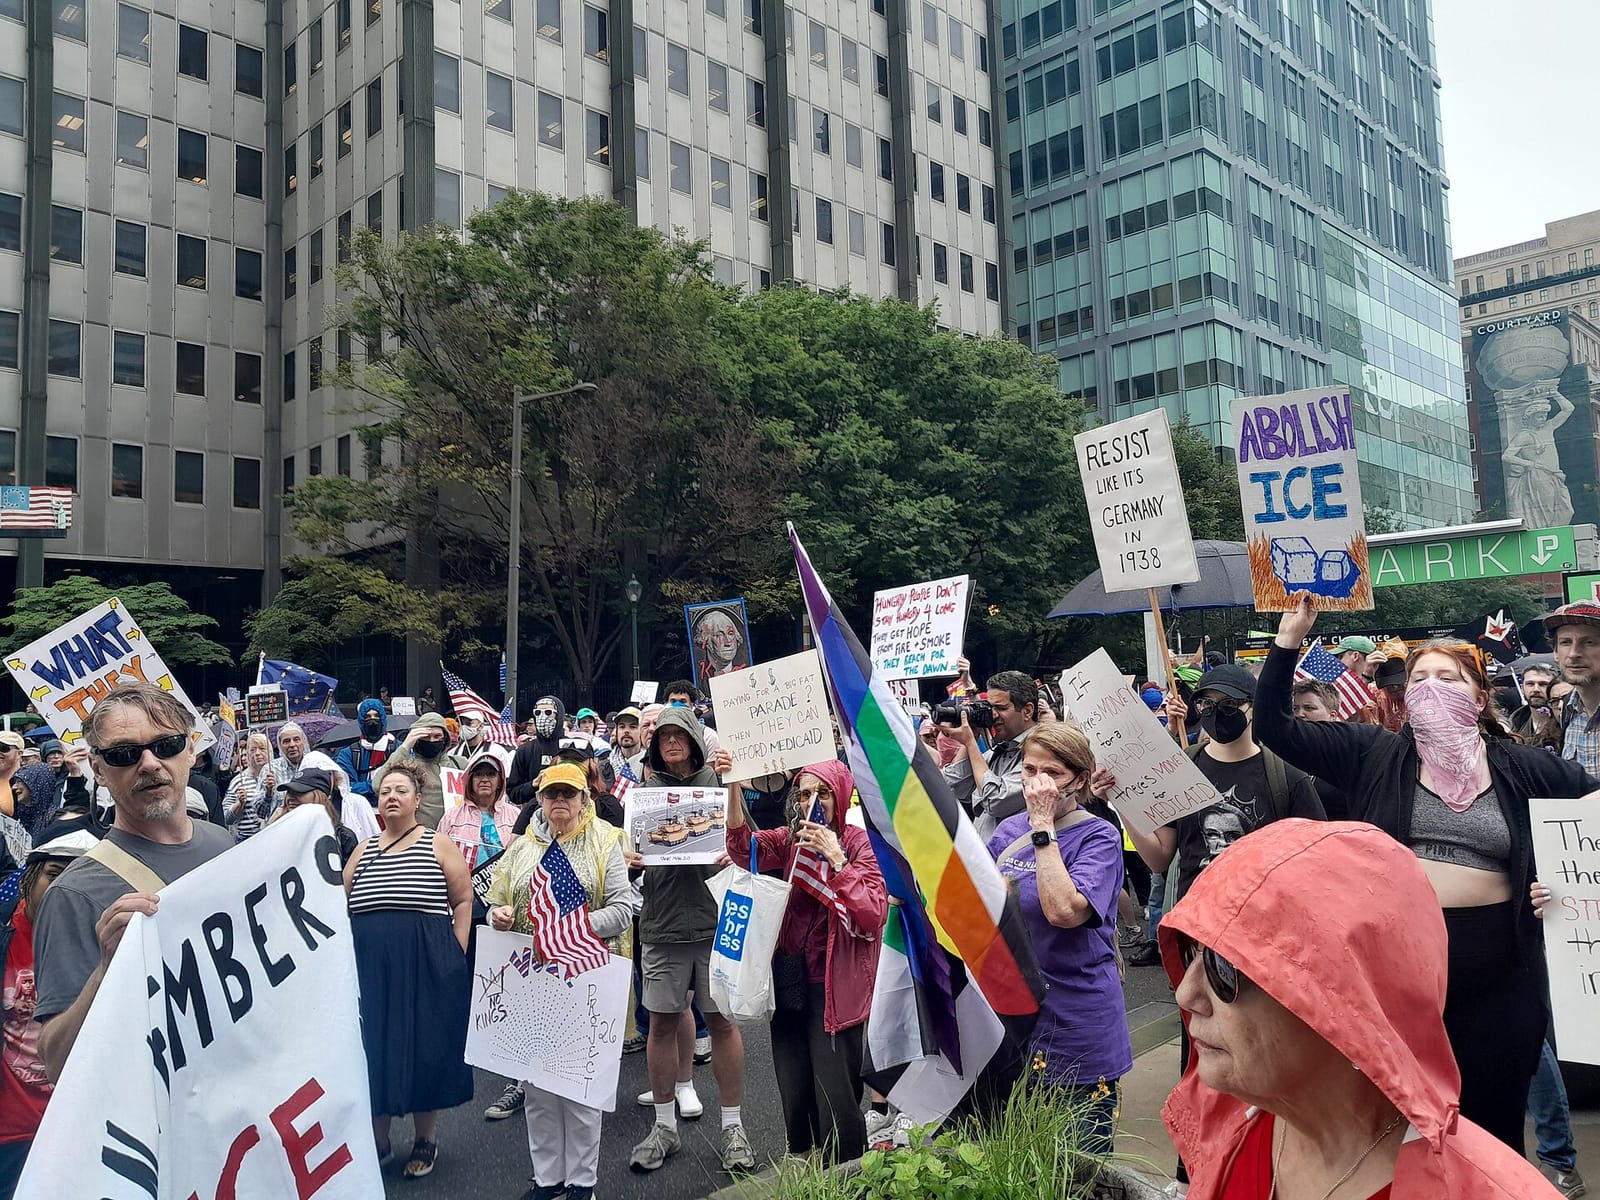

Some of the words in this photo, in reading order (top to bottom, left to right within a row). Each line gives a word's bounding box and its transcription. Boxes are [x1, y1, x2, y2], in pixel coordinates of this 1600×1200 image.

[1477, 310, 1561, 335] COURTYARD
[1239, 394, 1356, 463] ABOLISH
[1085, 428, 1151, 471] RESIST
[1096, 475, 1120, 495] LIKE
[1249, 463, 1349, 524] ICE
[1102, 494, 1164, 528] GERMANY
[1124, 530, 1142, 544] IN
[1119, 547, 1162, 573] 1938
[1375, 536, 1510, 586] ARK
[875, 592, 907, 613] HUNGRY
[935, 581, 962, 600] DON'T
[923, 603, 931, 622] 4
[935, 602, 957, 616] LONG
[890, 628, 904, 640] GET
[906, 621, 932, 640] HOPE
[919, 632, 952, 651] SMOKE
[1331, 634, 1390, 645] Clnce
[31, 610, 134, 691] WHAT
[884, 658, 900, 670] THEY
[930, 648, 945, 661] FOR
[903, 664, 919, 677] THE
[922, 661, 948, 675] DAWN
[723, 693, 751, 709] PAYING
[756, 687, 770, 700] FOR
[773, 684, 780, 693] A
[784, 679, 797, 690] BIG
[799, 673, 815, 686] FAT
[747, 691, 798, 720] PARADE
[1095, 683, 1138, 720] MONEY
[728, 730, 751, 744] THEN
[757, 715, 792, 736] THEY
[796, 705, 820, 725] CAN
[731, 742, 768, 763] AFFORD
[769, 727, 823, 754] MEDICAID
[1096, 731, 1114, 749] for
[1151, 750, 1188, 782] MONEY
[1143, 782, 1217, 827] MEDICAID
[489, 994, 501, 1009] NO
[475, 1005, 507, 1031] KINGS
[599, 1018, 617, 1044] 26
[584, 983, 600, 1099] PROJECT
